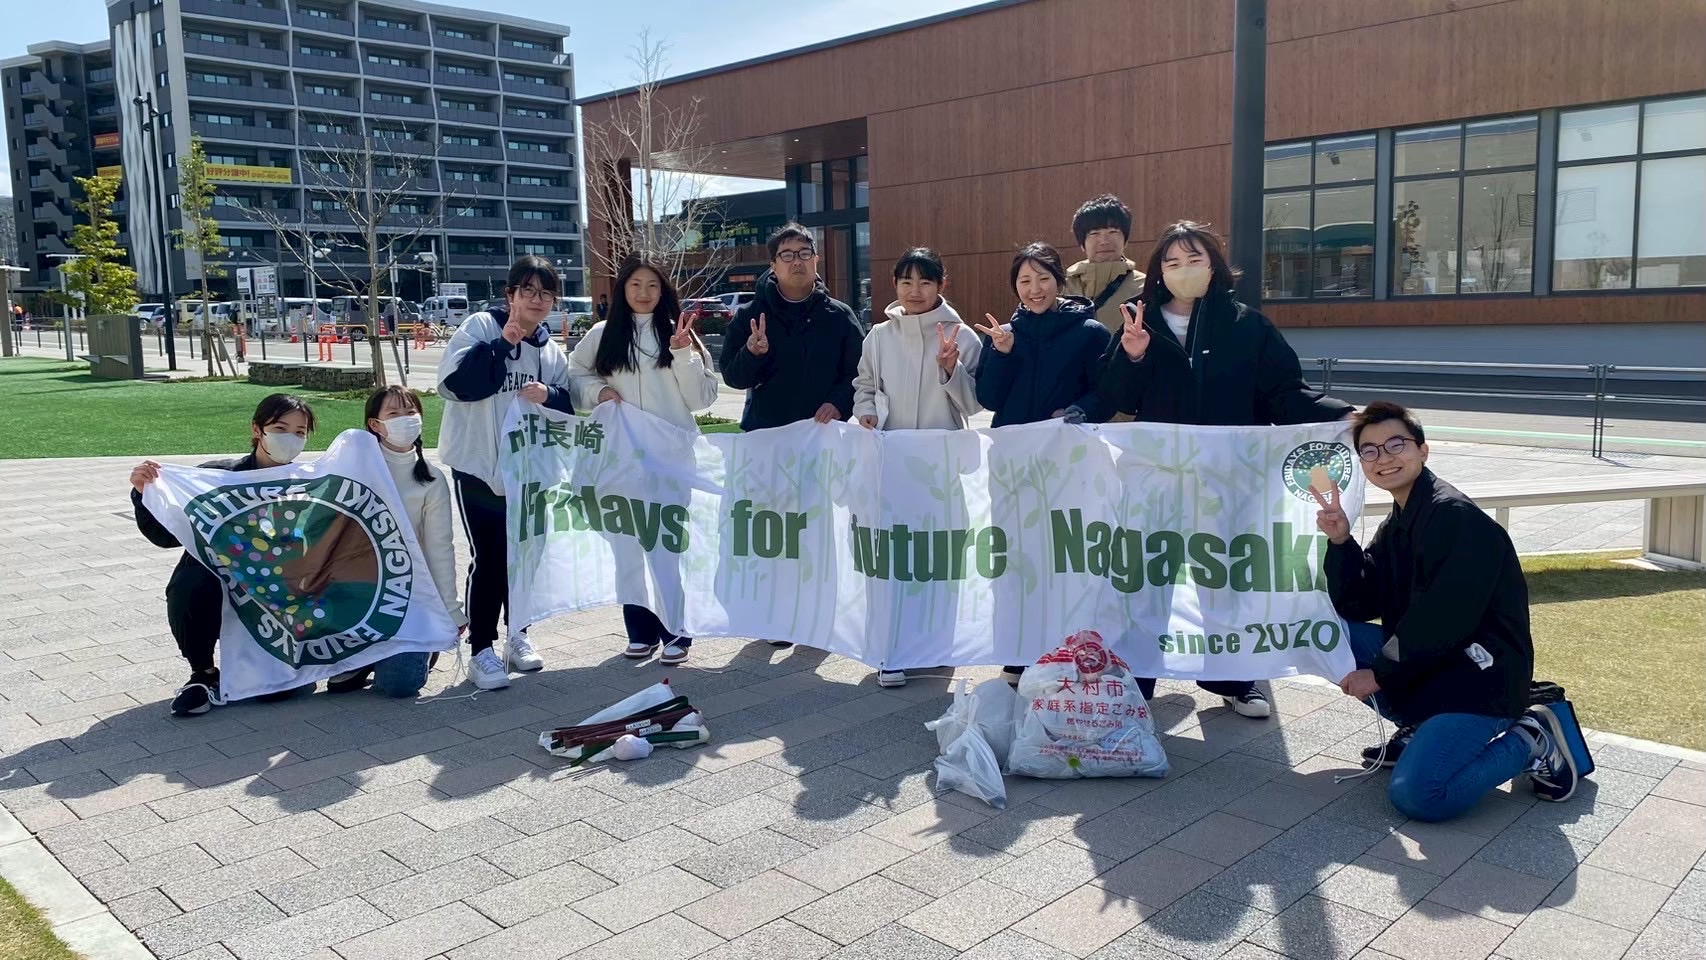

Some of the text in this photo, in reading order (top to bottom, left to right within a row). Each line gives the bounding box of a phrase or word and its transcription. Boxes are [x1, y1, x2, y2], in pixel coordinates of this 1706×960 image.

[1284, 447, 1305, 486] FRIDAYS
[1334, 444, 1351, 481] FUTURE
[335, 478, 412, 618] NAGASAKI
[731, 499, 807, 559] for
[1159, 619, 1340, 653] since 2020
[1056, 677, 1124, 697] 大村市
[1032, 698, 1148, 719] 家庭系指定ごみ袋
